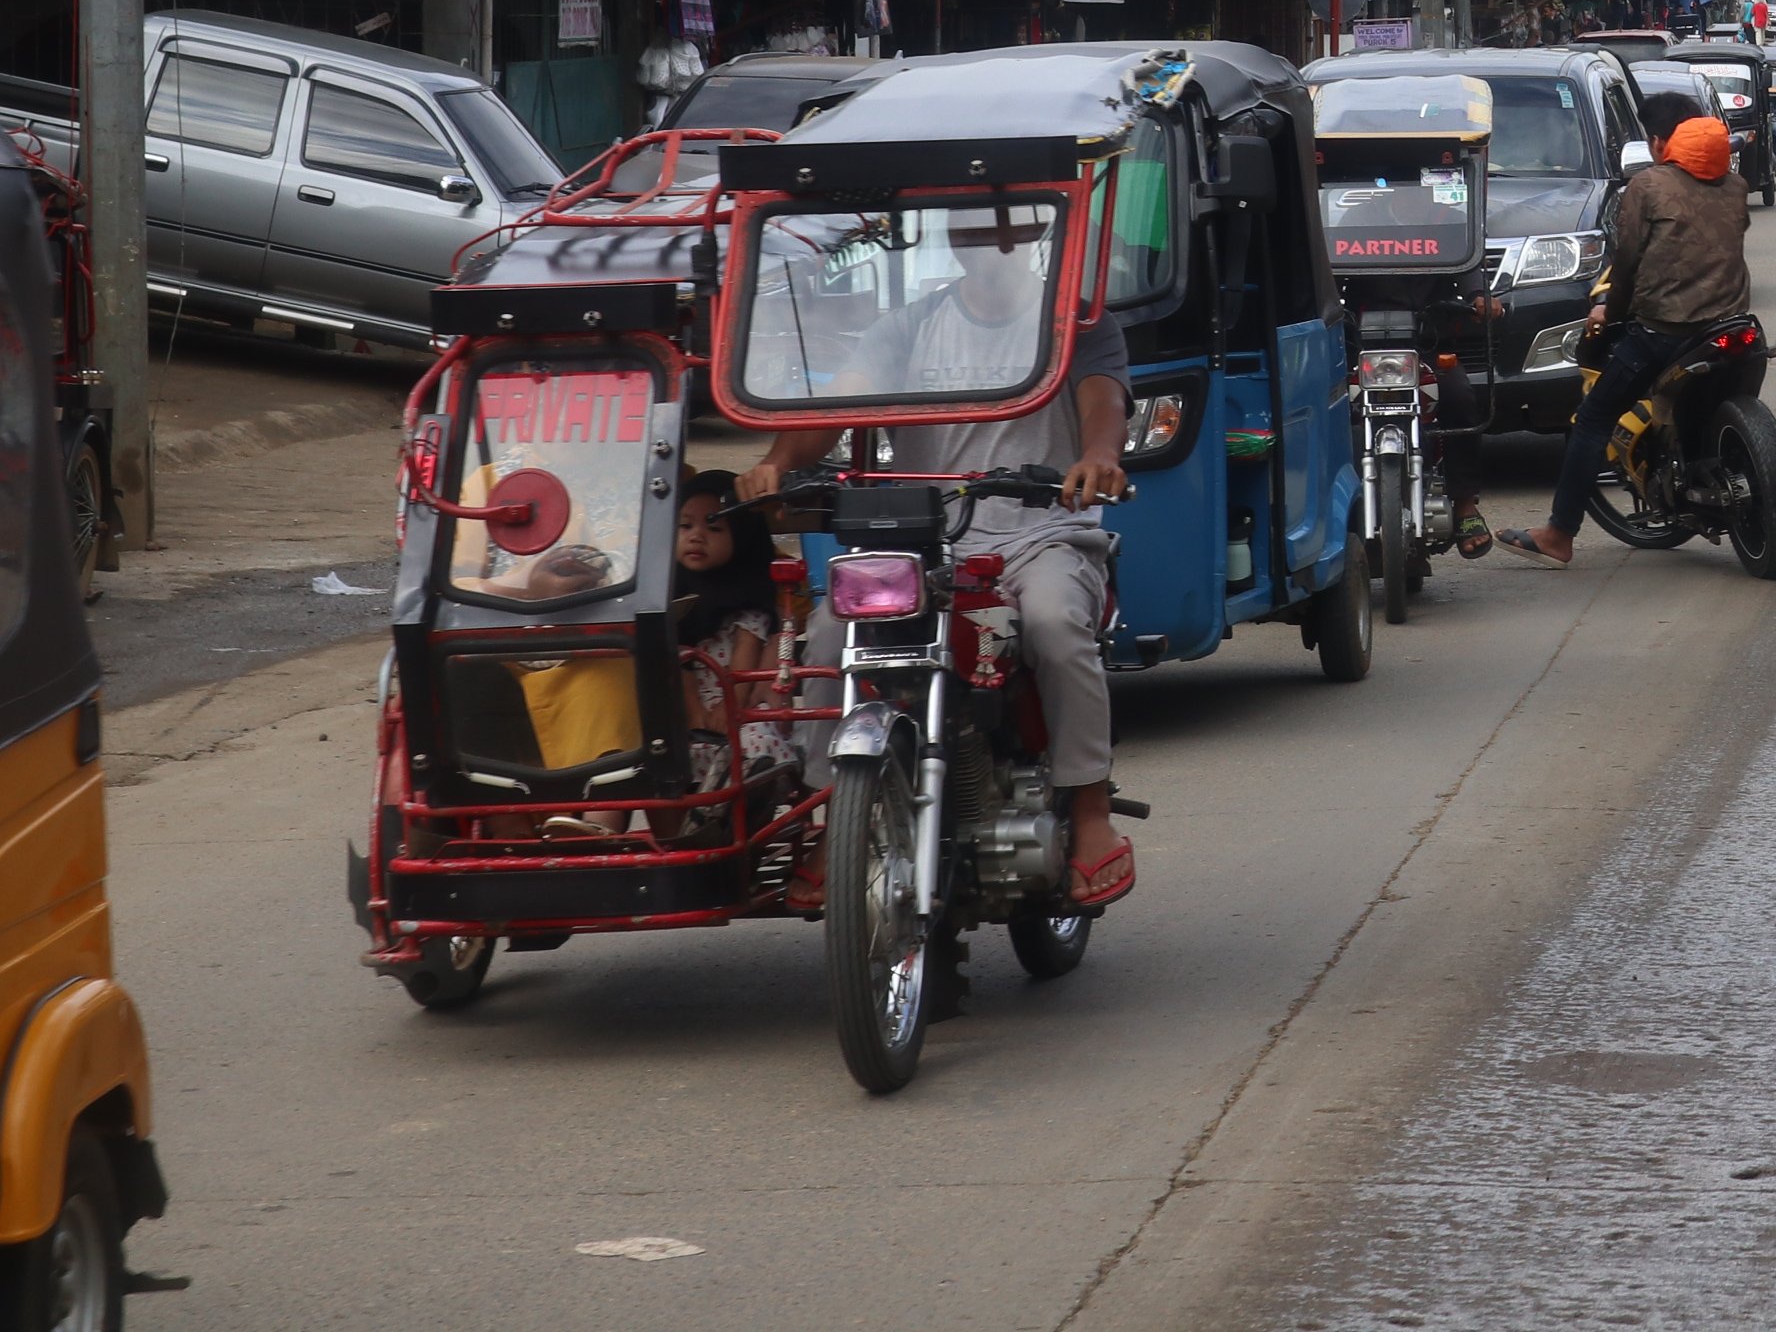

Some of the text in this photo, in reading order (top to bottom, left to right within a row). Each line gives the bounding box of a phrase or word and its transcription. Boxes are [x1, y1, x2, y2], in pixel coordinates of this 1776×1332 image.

[1449, 191, 1465, 201] 41
[1335, 238, 1441, 256] PARTNER
[474, 372, 651, 444] PRIVATE
